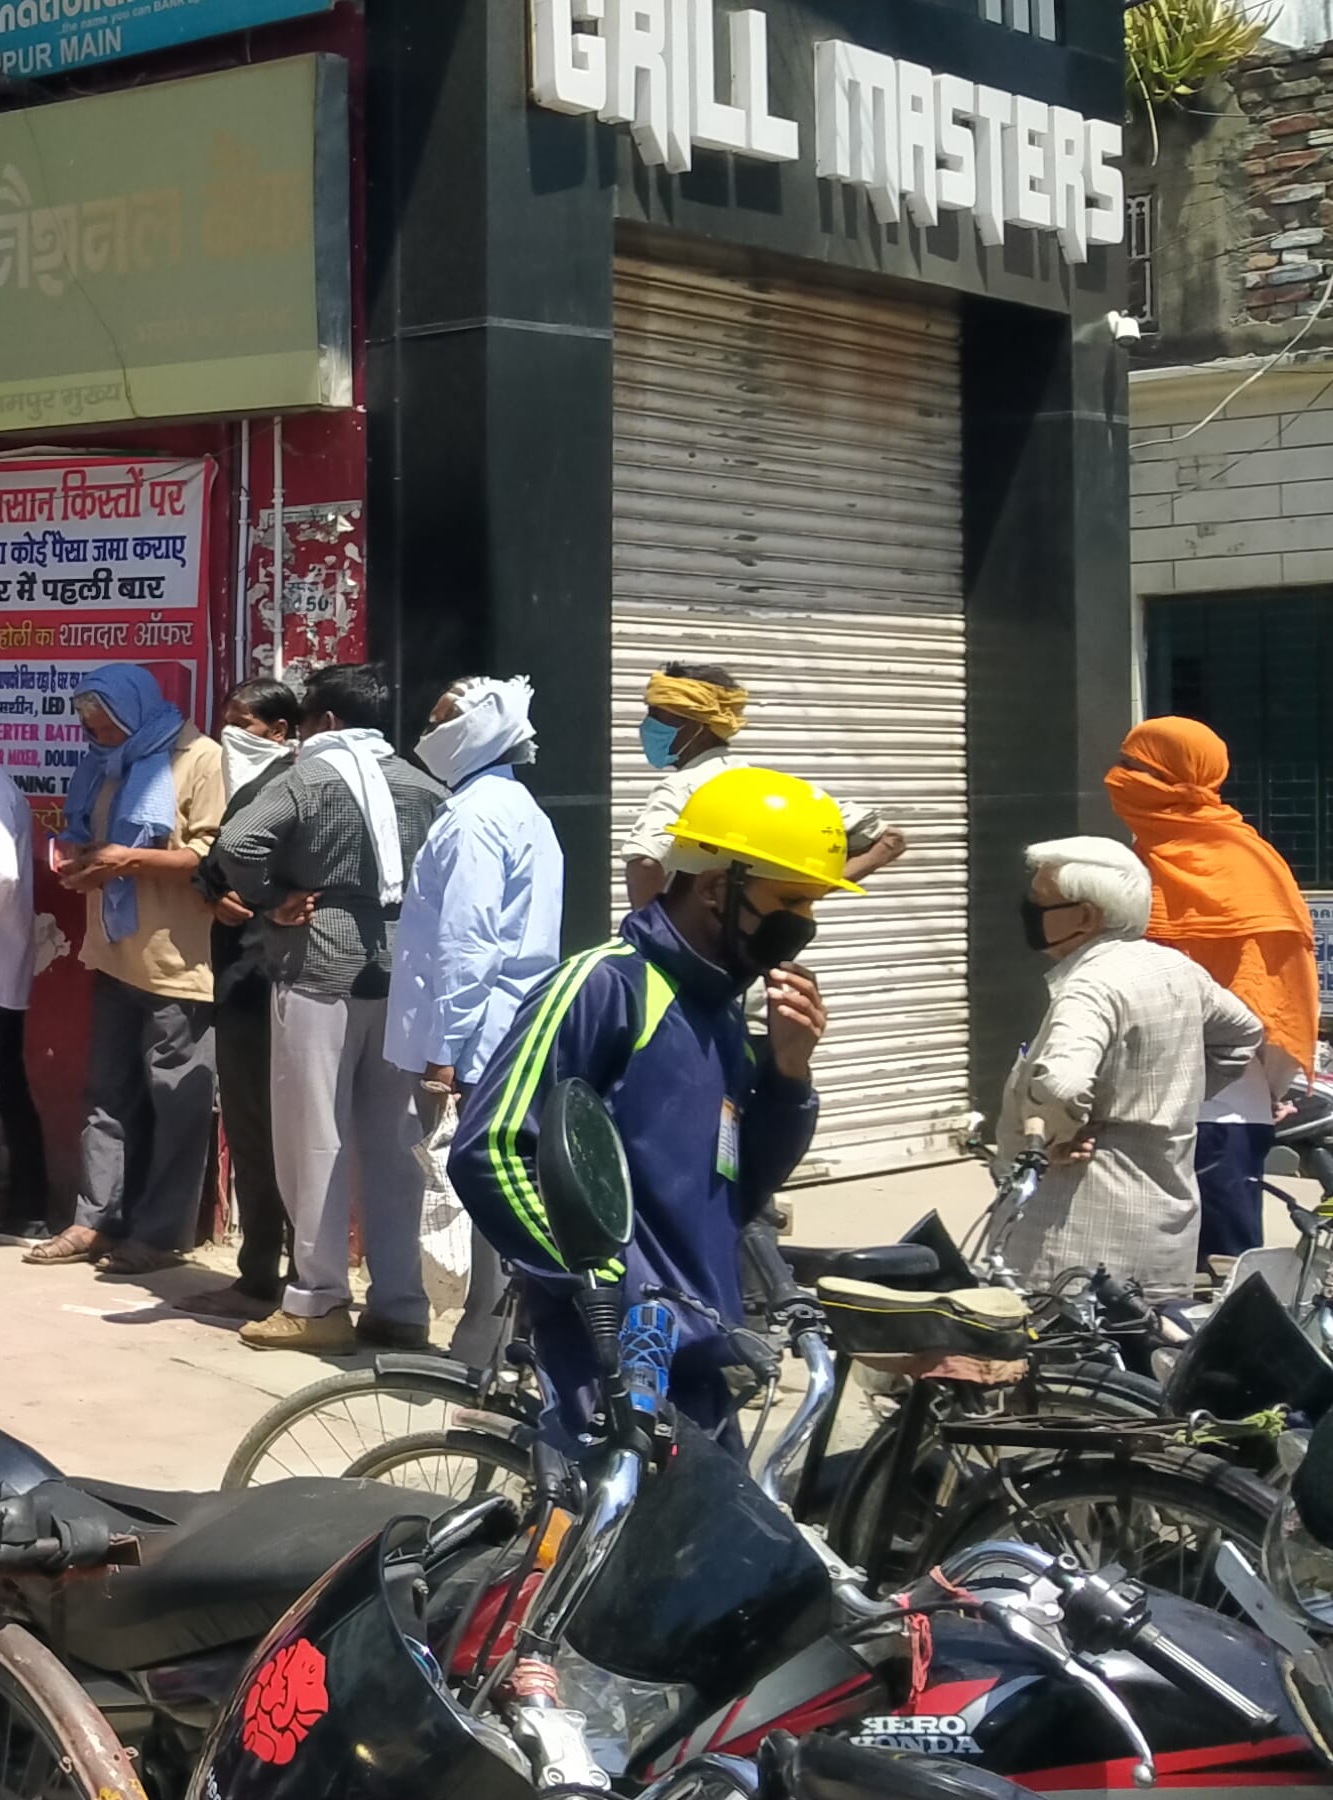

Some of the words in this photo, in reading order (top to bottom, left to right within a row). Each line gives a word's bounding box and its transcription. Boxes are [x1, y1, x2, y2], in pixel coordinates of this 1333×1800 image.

[59, 25, 123, 59] MAIN
[534, 0, 799, 173] GRILL
[814, 38, 1124, 264] MASTERS
[61, 465, 144, 520] किस्तों
[149, 479, 187, 517] पर
[10, 531, 49, 569] कोई
[51, 531, 89, 565] पैसा
[92, 538, 129, 563] जमा
[131, 535, 188, 570] कराए
[15, 570, 40, 602] में
[42, 567, 115, 604] पहली
[117, 574, 165, 600] बार
[34, 628, 55, 647] का
[59, 621, 129, 650] शानदार
[133, 611, 195, 647] ऑफर
[42, 696, 65, 716] LED
[45, 723, 88, 743] BATT
[11, 775, 56, 794] NING
[860, 1715, 967, 1735] HERO
[848, 1735, 985, 1754] HONDA
